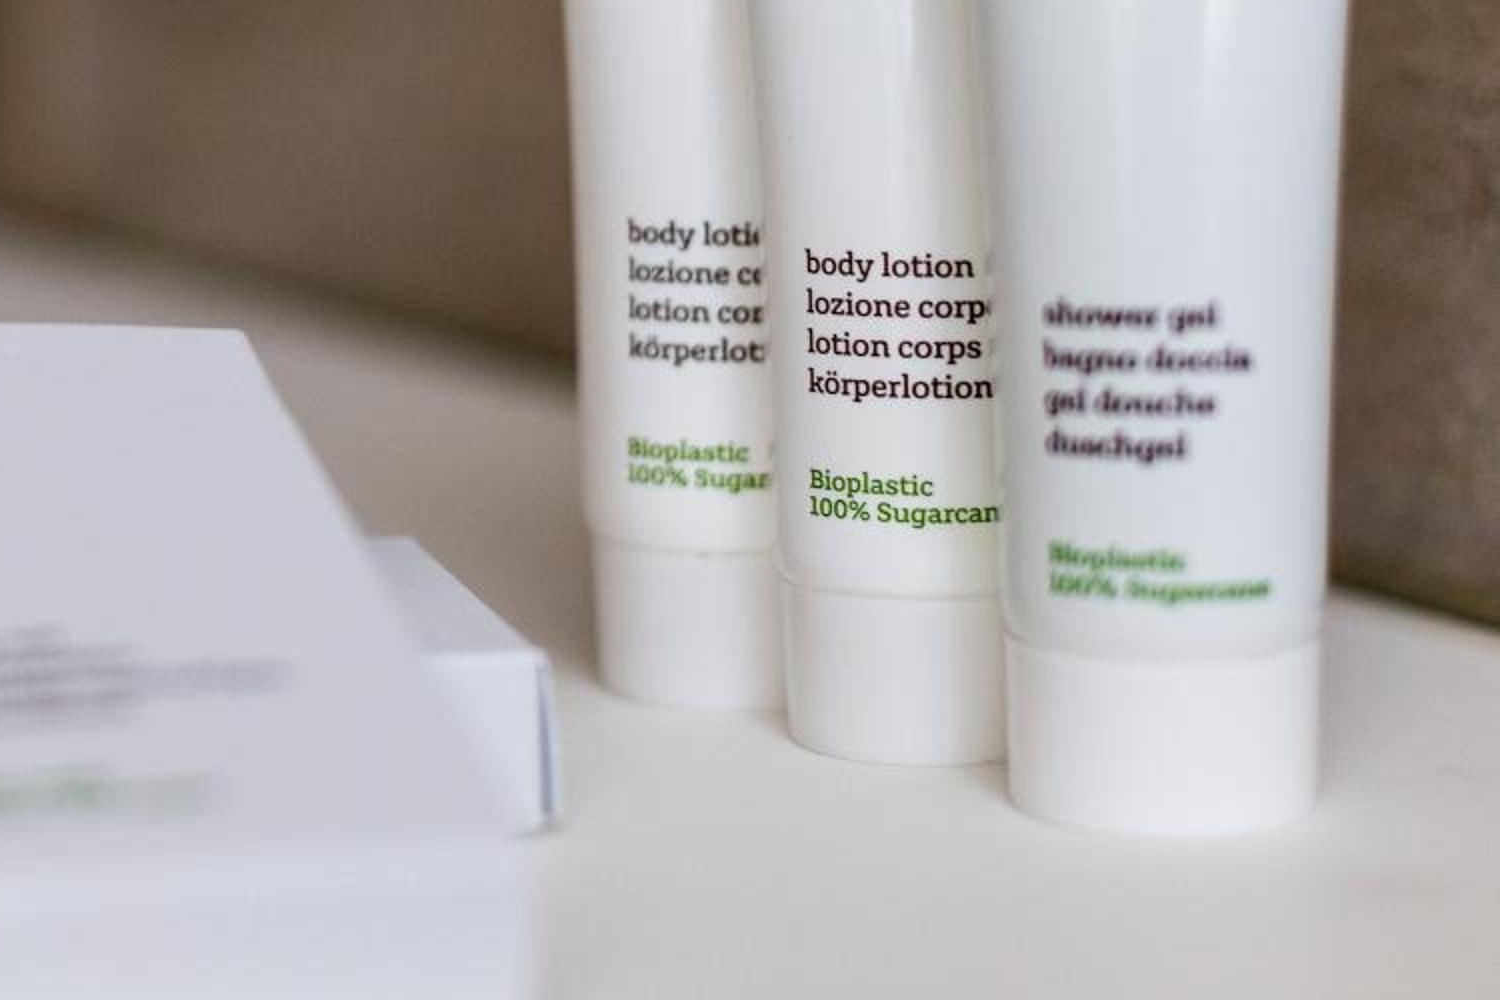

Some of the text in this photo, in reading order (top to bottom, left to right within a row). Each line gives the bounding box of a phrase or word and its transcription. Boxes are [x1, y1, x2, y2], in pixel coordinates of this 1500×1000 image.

[628, 218, 695, 252] body
[628, 257, 729, 286] lozione
[804, 248, 975, 282] body lotion
[628, 296, 710, 324] lotion
[806, 288, 911, 319] lozione
[1043, 297, 1218, 335] shower gel
[807, 328, 983, 365] lotion corps
[808, 368, 995, 402] körperlotion
[627, 437, 750, 464] Bioplastic
[627, 463, 688, 487] 100%
[809, 469, 934, 498] Bioplastic
[809, 496, 871, 522] 100%
